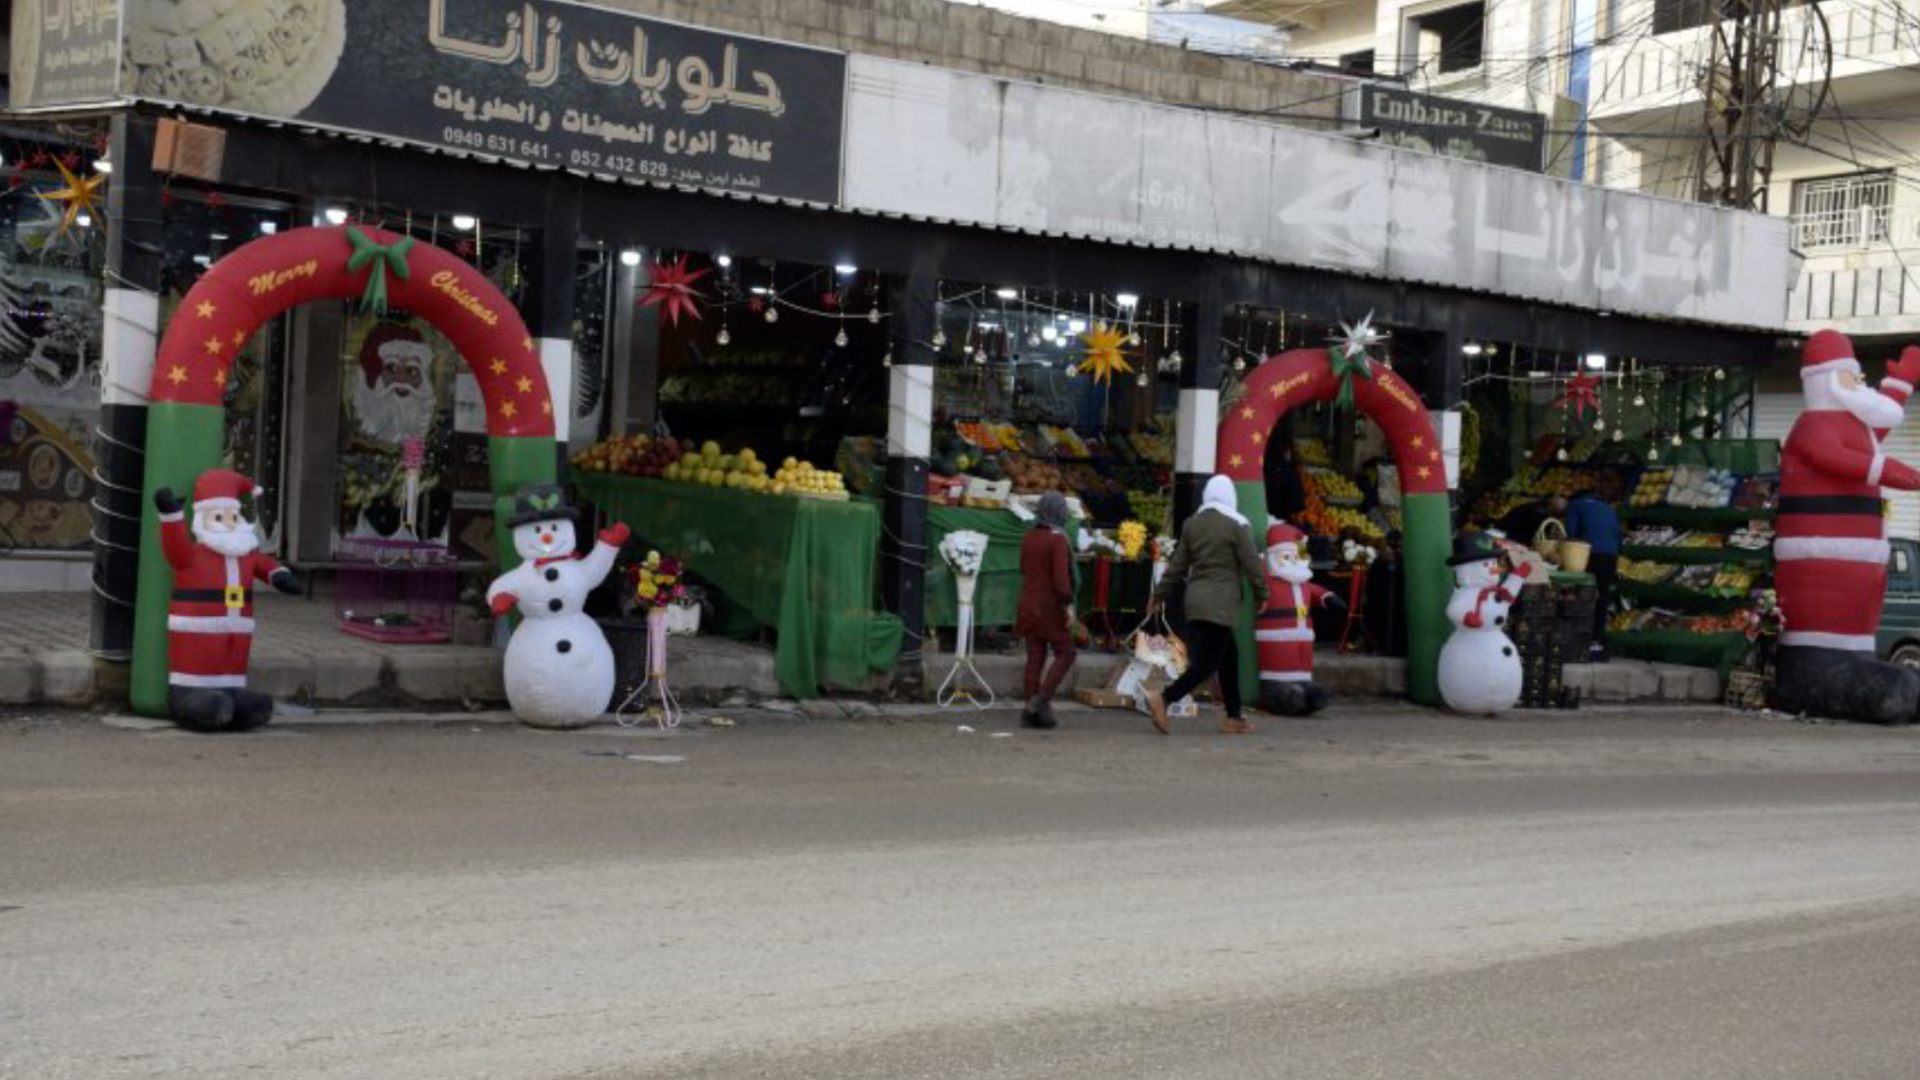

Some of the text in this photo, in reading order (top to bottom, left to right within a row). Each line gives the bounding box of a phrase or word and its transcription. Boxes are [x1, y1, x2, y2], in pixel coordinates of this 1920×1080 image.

[429, 0, 786, 118] حلويات زانا
[432, 84, 773, 162] كافة انواع المعجنات والحلويات
[1372, 91, 1468, 128] Embara
[442, 126, 484, 149] 0949
[487, 134, 517, 154] 631
[520, 141, 549, 160] 641
[570, 149, 601, 169] 052
[604, 154, 635, 174] 432
[639, 159, 669, 178] 629
[248, 258, 498, 326] Merry Christmas
